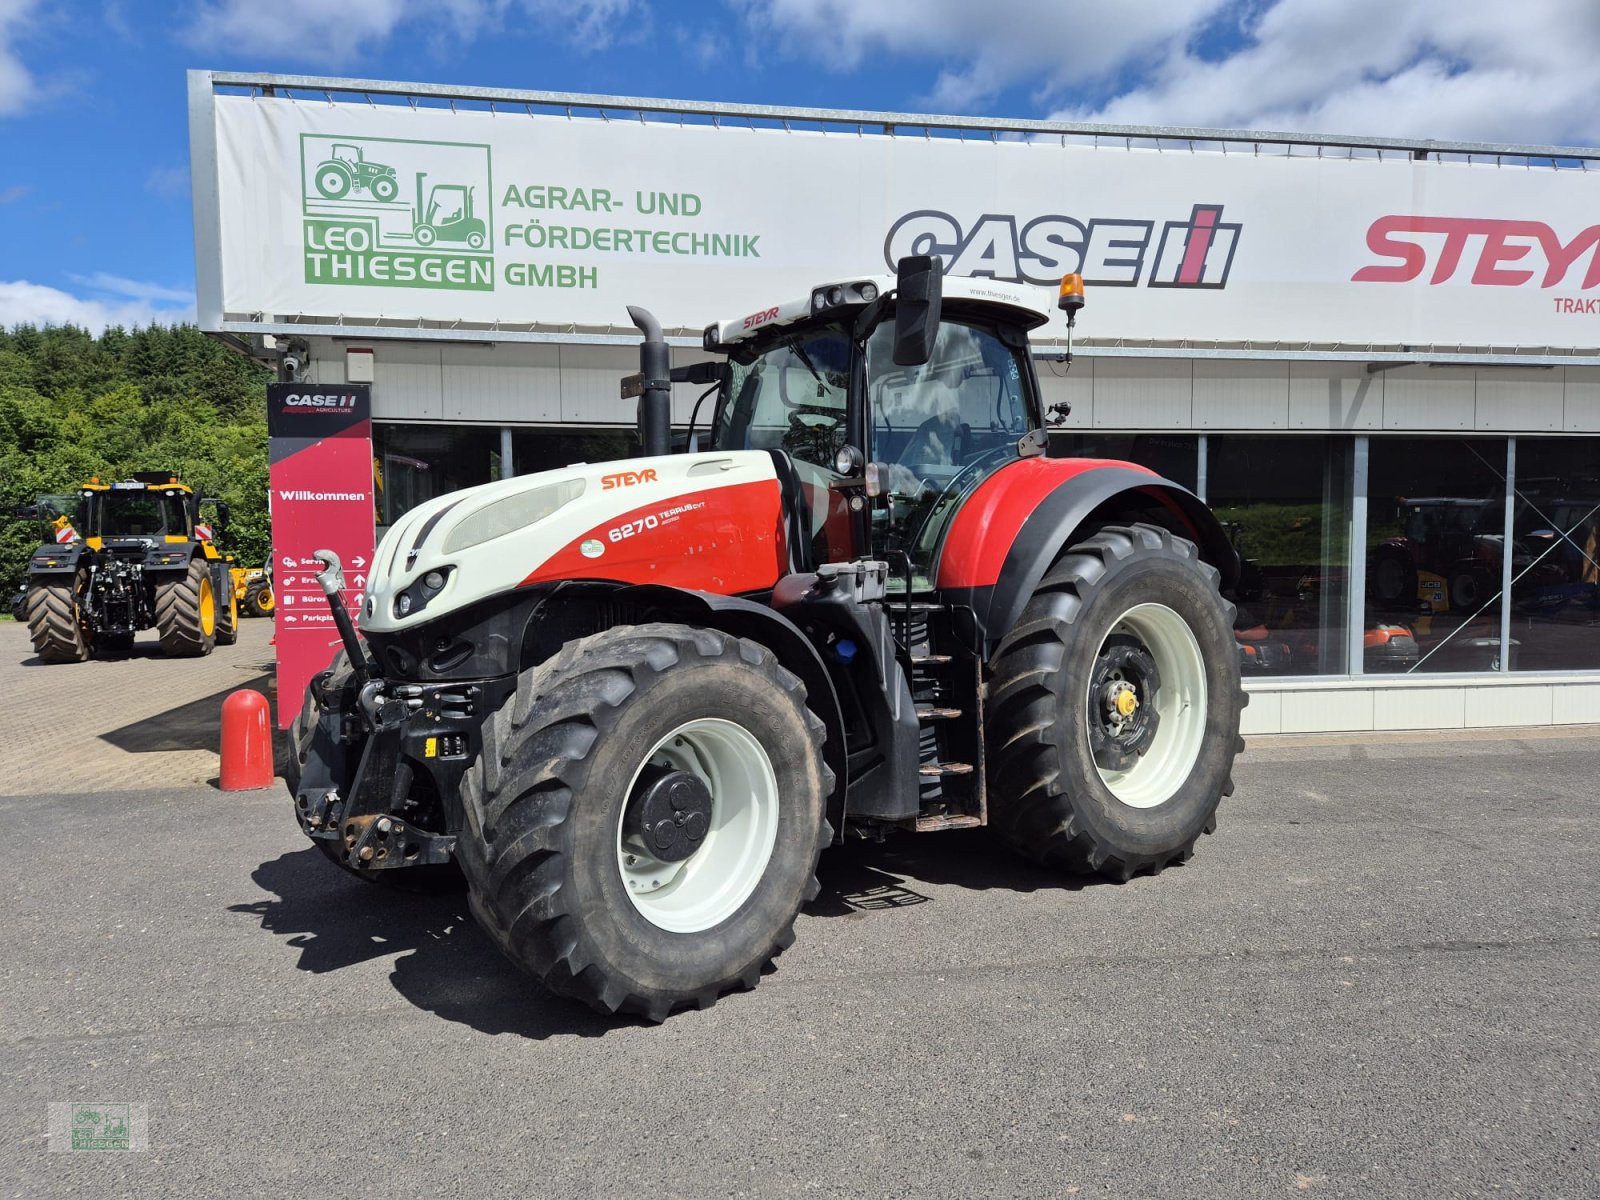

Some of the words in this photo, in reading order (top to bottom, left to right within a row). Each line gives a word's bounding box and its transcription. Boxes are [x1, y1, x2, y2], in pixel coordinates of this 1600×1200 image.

[501, 184, 624, 213] AGRAR-
[636, 190, 702, 217] UND
[307, 225, 370, 252] LEO
[504, 218, 761, 258] FÖRDERTECHNIK
[883, 209, 1155, 288] CASE
[1350, 214, 1600, 290] STEY
[306, 253, 492, 285] THIESGEN
[504, 262, 598, 289] GMBH
[743, 306, 779, 330] STEYR
[285, 394, 338, 407] CASE
[600, 468, 659, 491] STEYR
[279, 490, 365, 501] Willkommen
[608, 515, 659, 543] 6270
